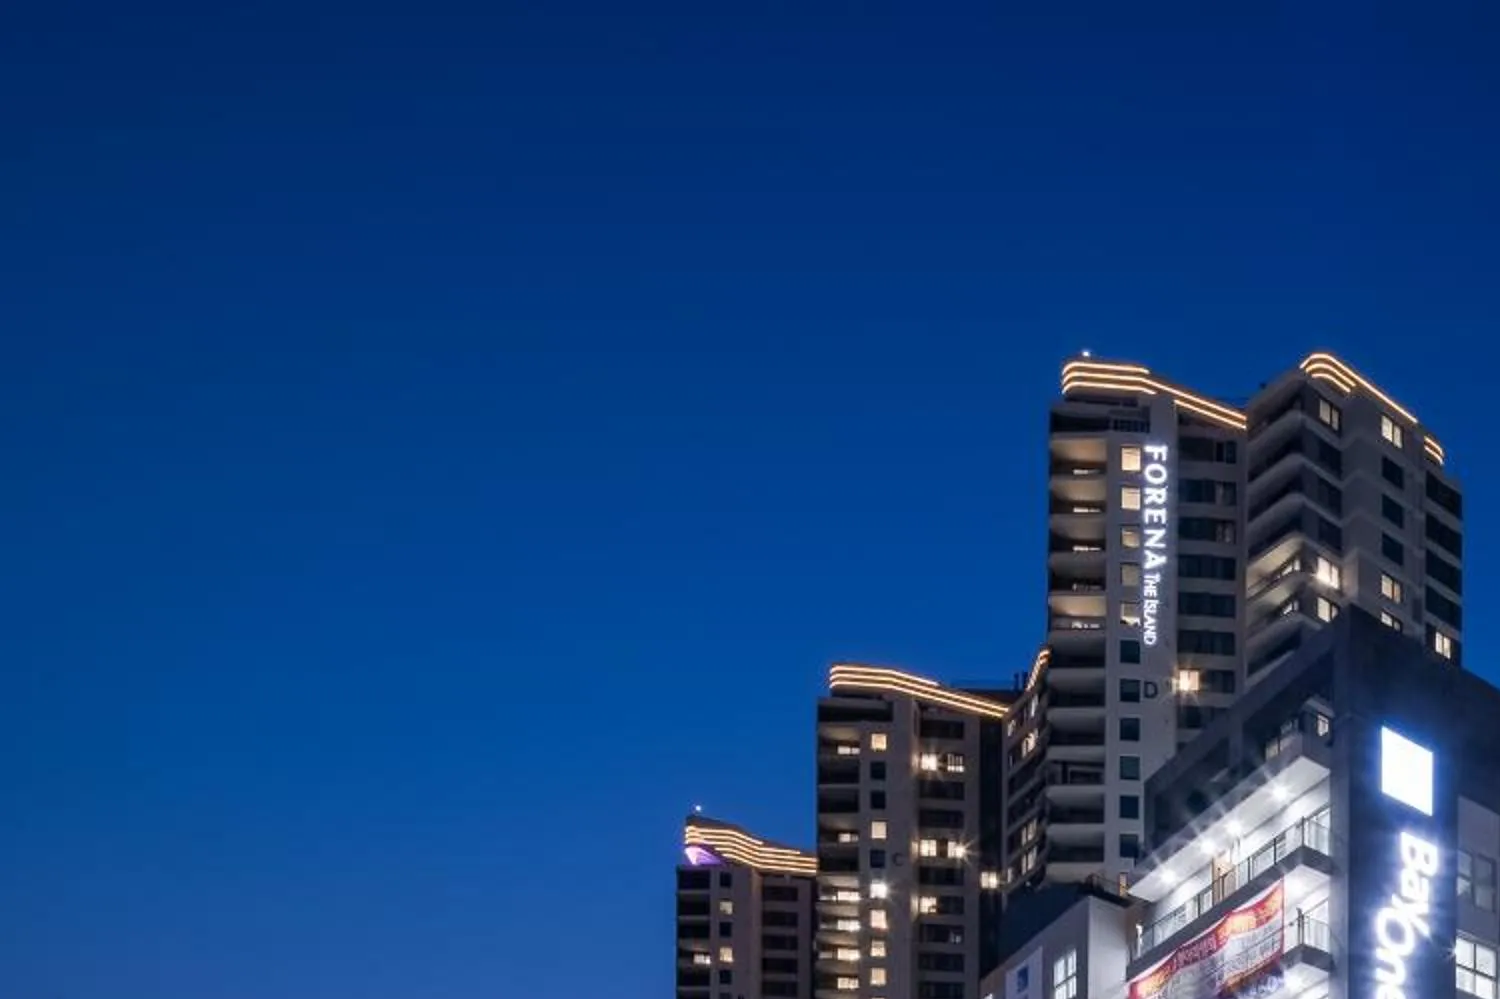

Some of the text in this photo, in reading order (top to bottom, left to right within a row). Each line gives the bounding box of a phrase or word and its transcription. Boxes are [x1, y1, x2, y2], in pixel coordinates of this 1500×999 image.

[1143, 445, 1168, 645] FORENA THE ISLAND
[1144, 682, 1158, 698] D
